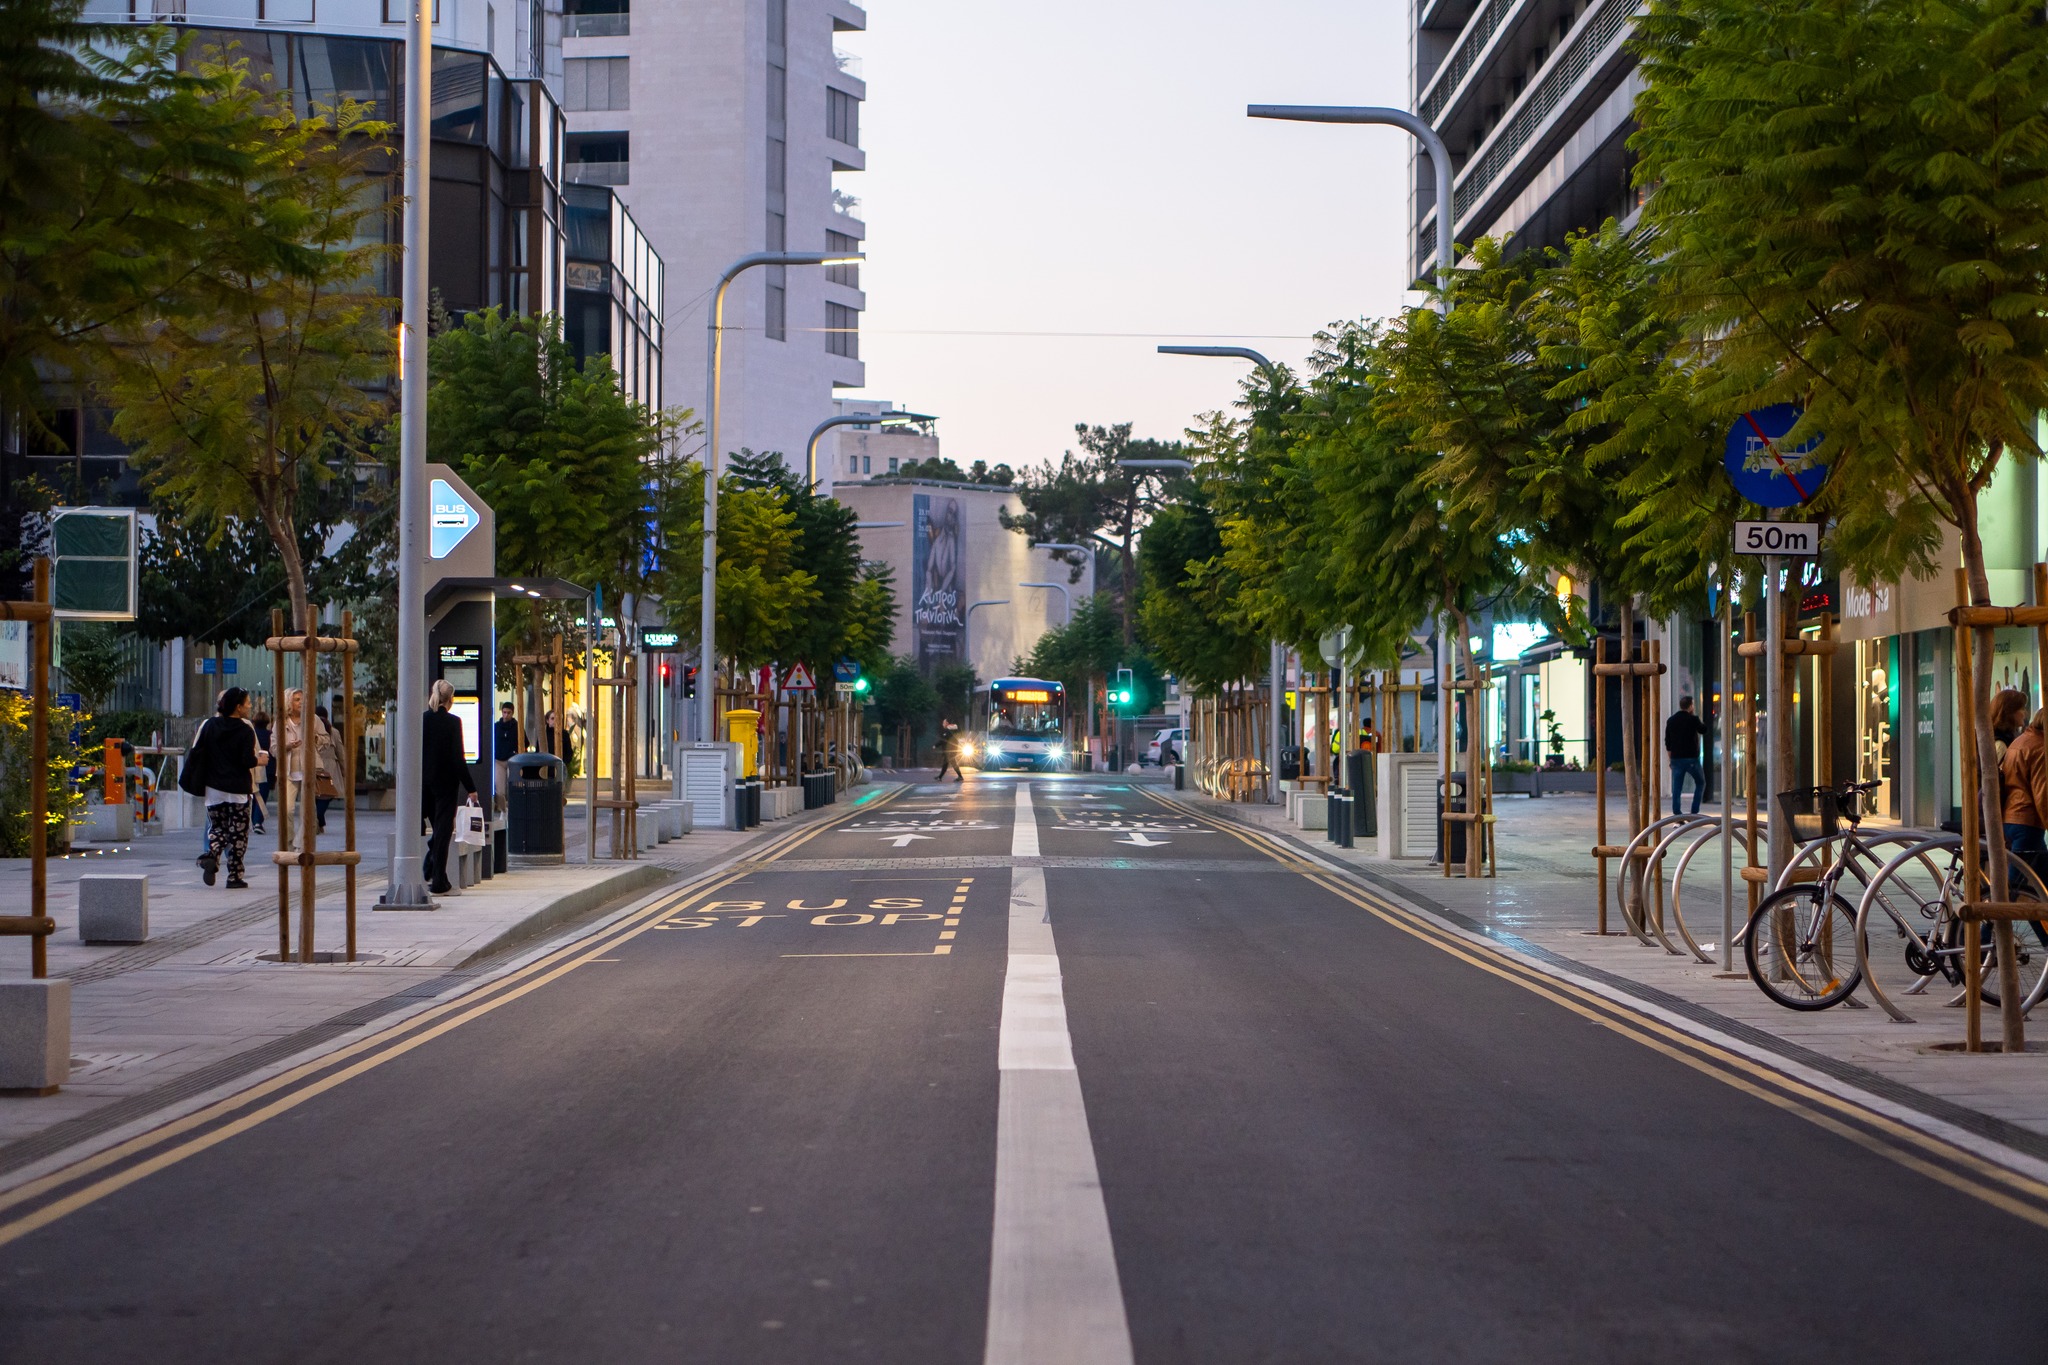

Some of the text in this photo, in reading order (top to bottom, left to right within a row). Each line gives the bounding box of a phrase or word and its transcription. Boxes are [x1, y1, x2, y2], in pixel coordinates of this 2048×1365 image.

[436, 504, 466, 514] BUS
[1747, 526, 1808, 550] 50m
[918, 587, 957, 610] Κύπρος
[696, 898, 924, 913] BUS
[653, 913, 944, 930] STOP
